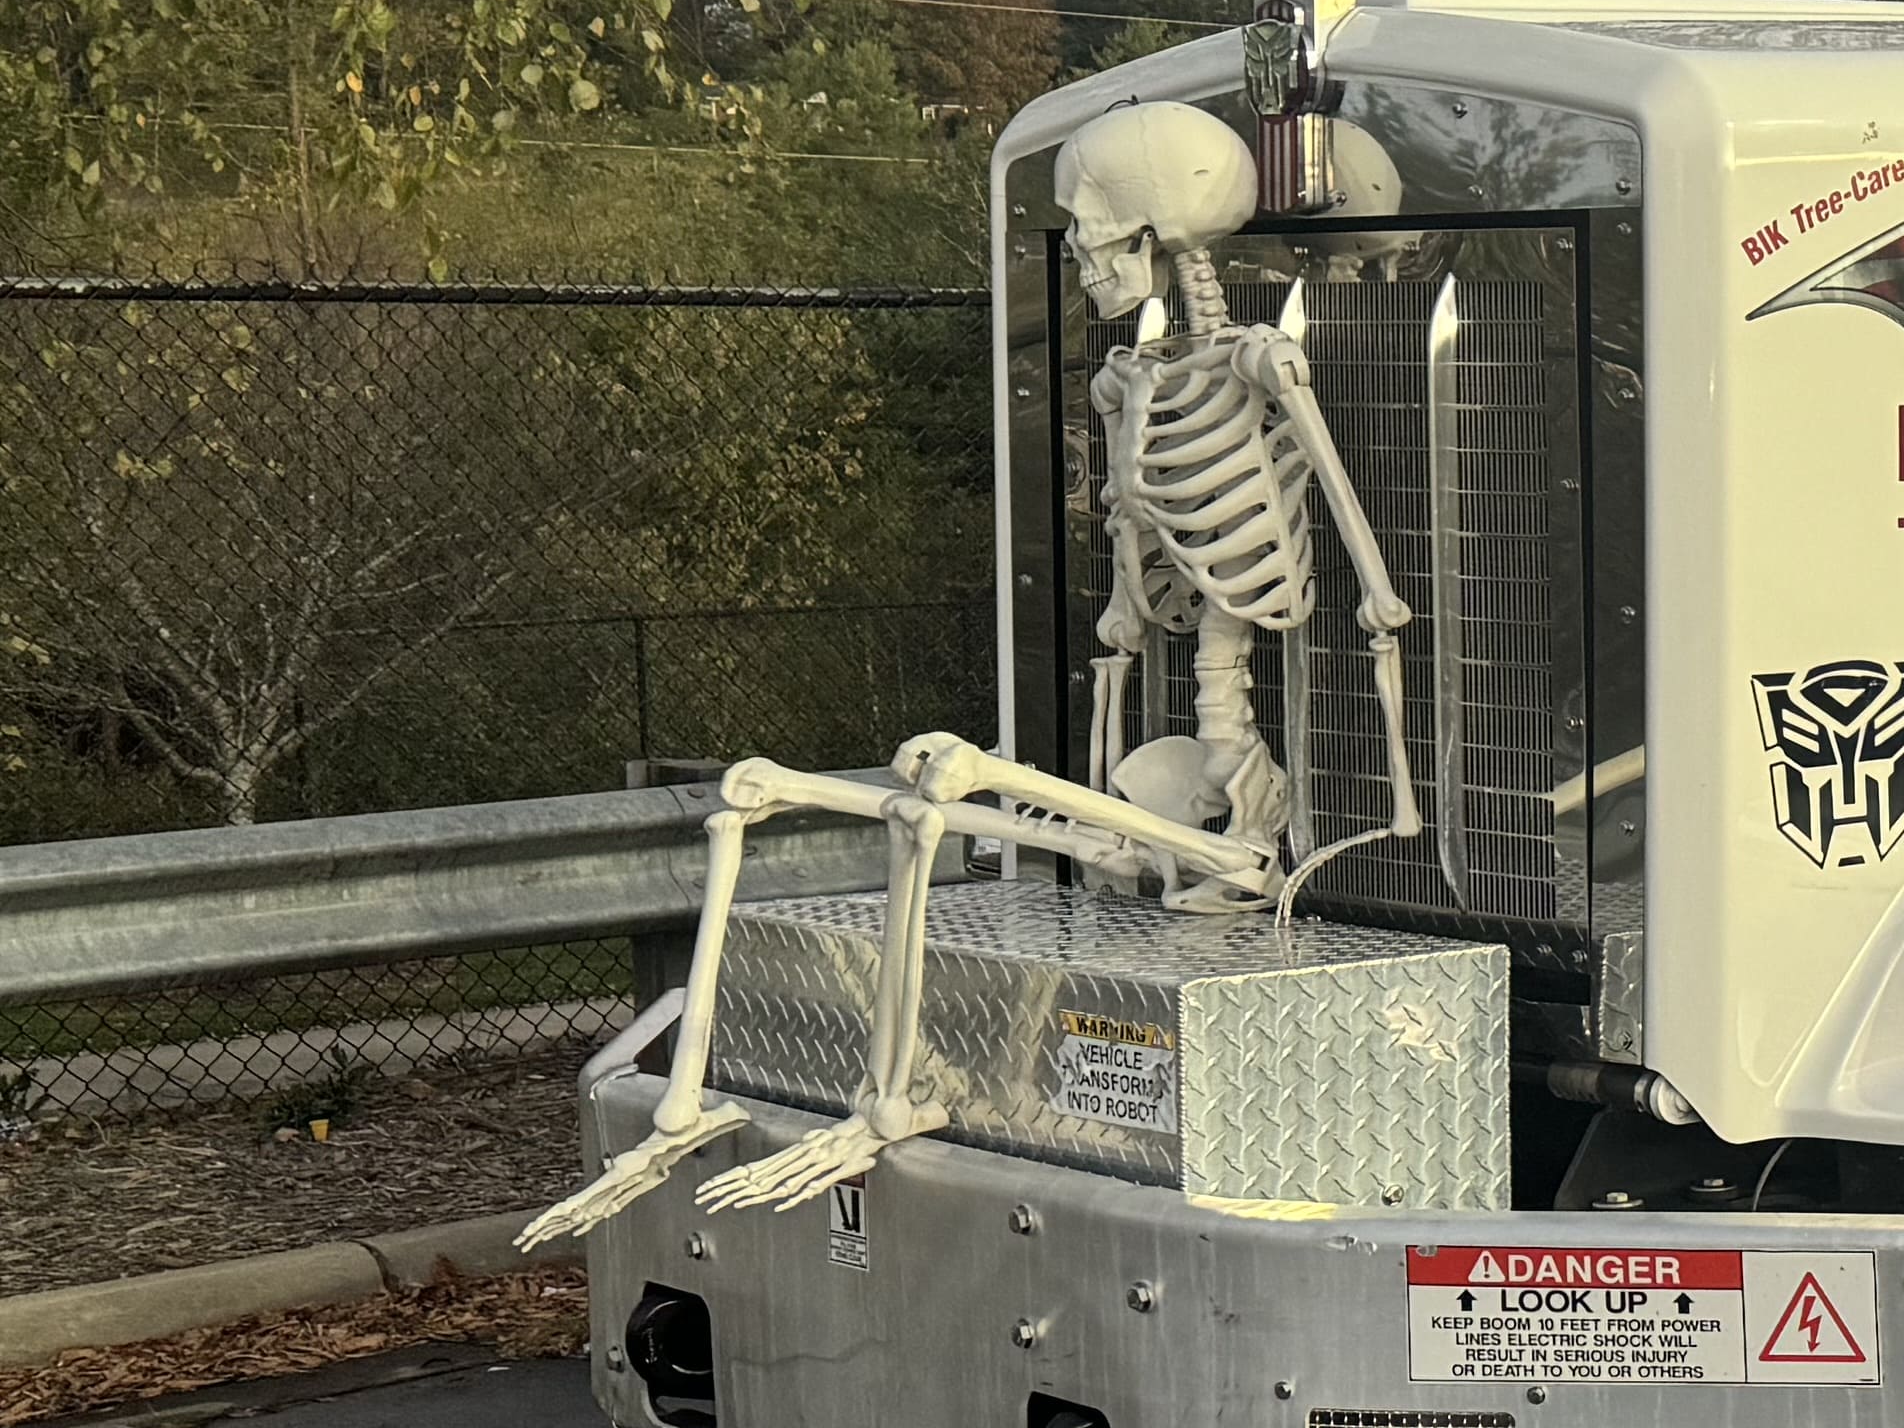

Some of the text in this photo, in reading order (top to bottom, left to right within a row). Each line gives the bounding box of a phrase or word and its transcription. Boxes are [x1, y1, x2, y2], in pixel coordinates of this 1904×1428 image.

[1740, 219, 1789, 267] BIK
[1076, 1016, 1147, 1043] WARNING
[1078, 1042, 1143, 1071] VEHICLE
[1067, 1090, 1158, 1124] INTO ROBOT
[1508, 1254, 1681, 1285] DANGER
[1501, 1289, 1648, 1314] LOOK UP
[1431, 1316, 1721, 1333] KEEP BOOM 10 FEET FROM POWER
[1455, 1332, 1698, 1348] LINES ELECTRIC SHOCK WILL
[1465, 1348, 1688, 1364] RESULT IN SERIOUS INJURY
[1452, 1363, 1704, 1379] OR DEATH TO YOU OR OTHERS
